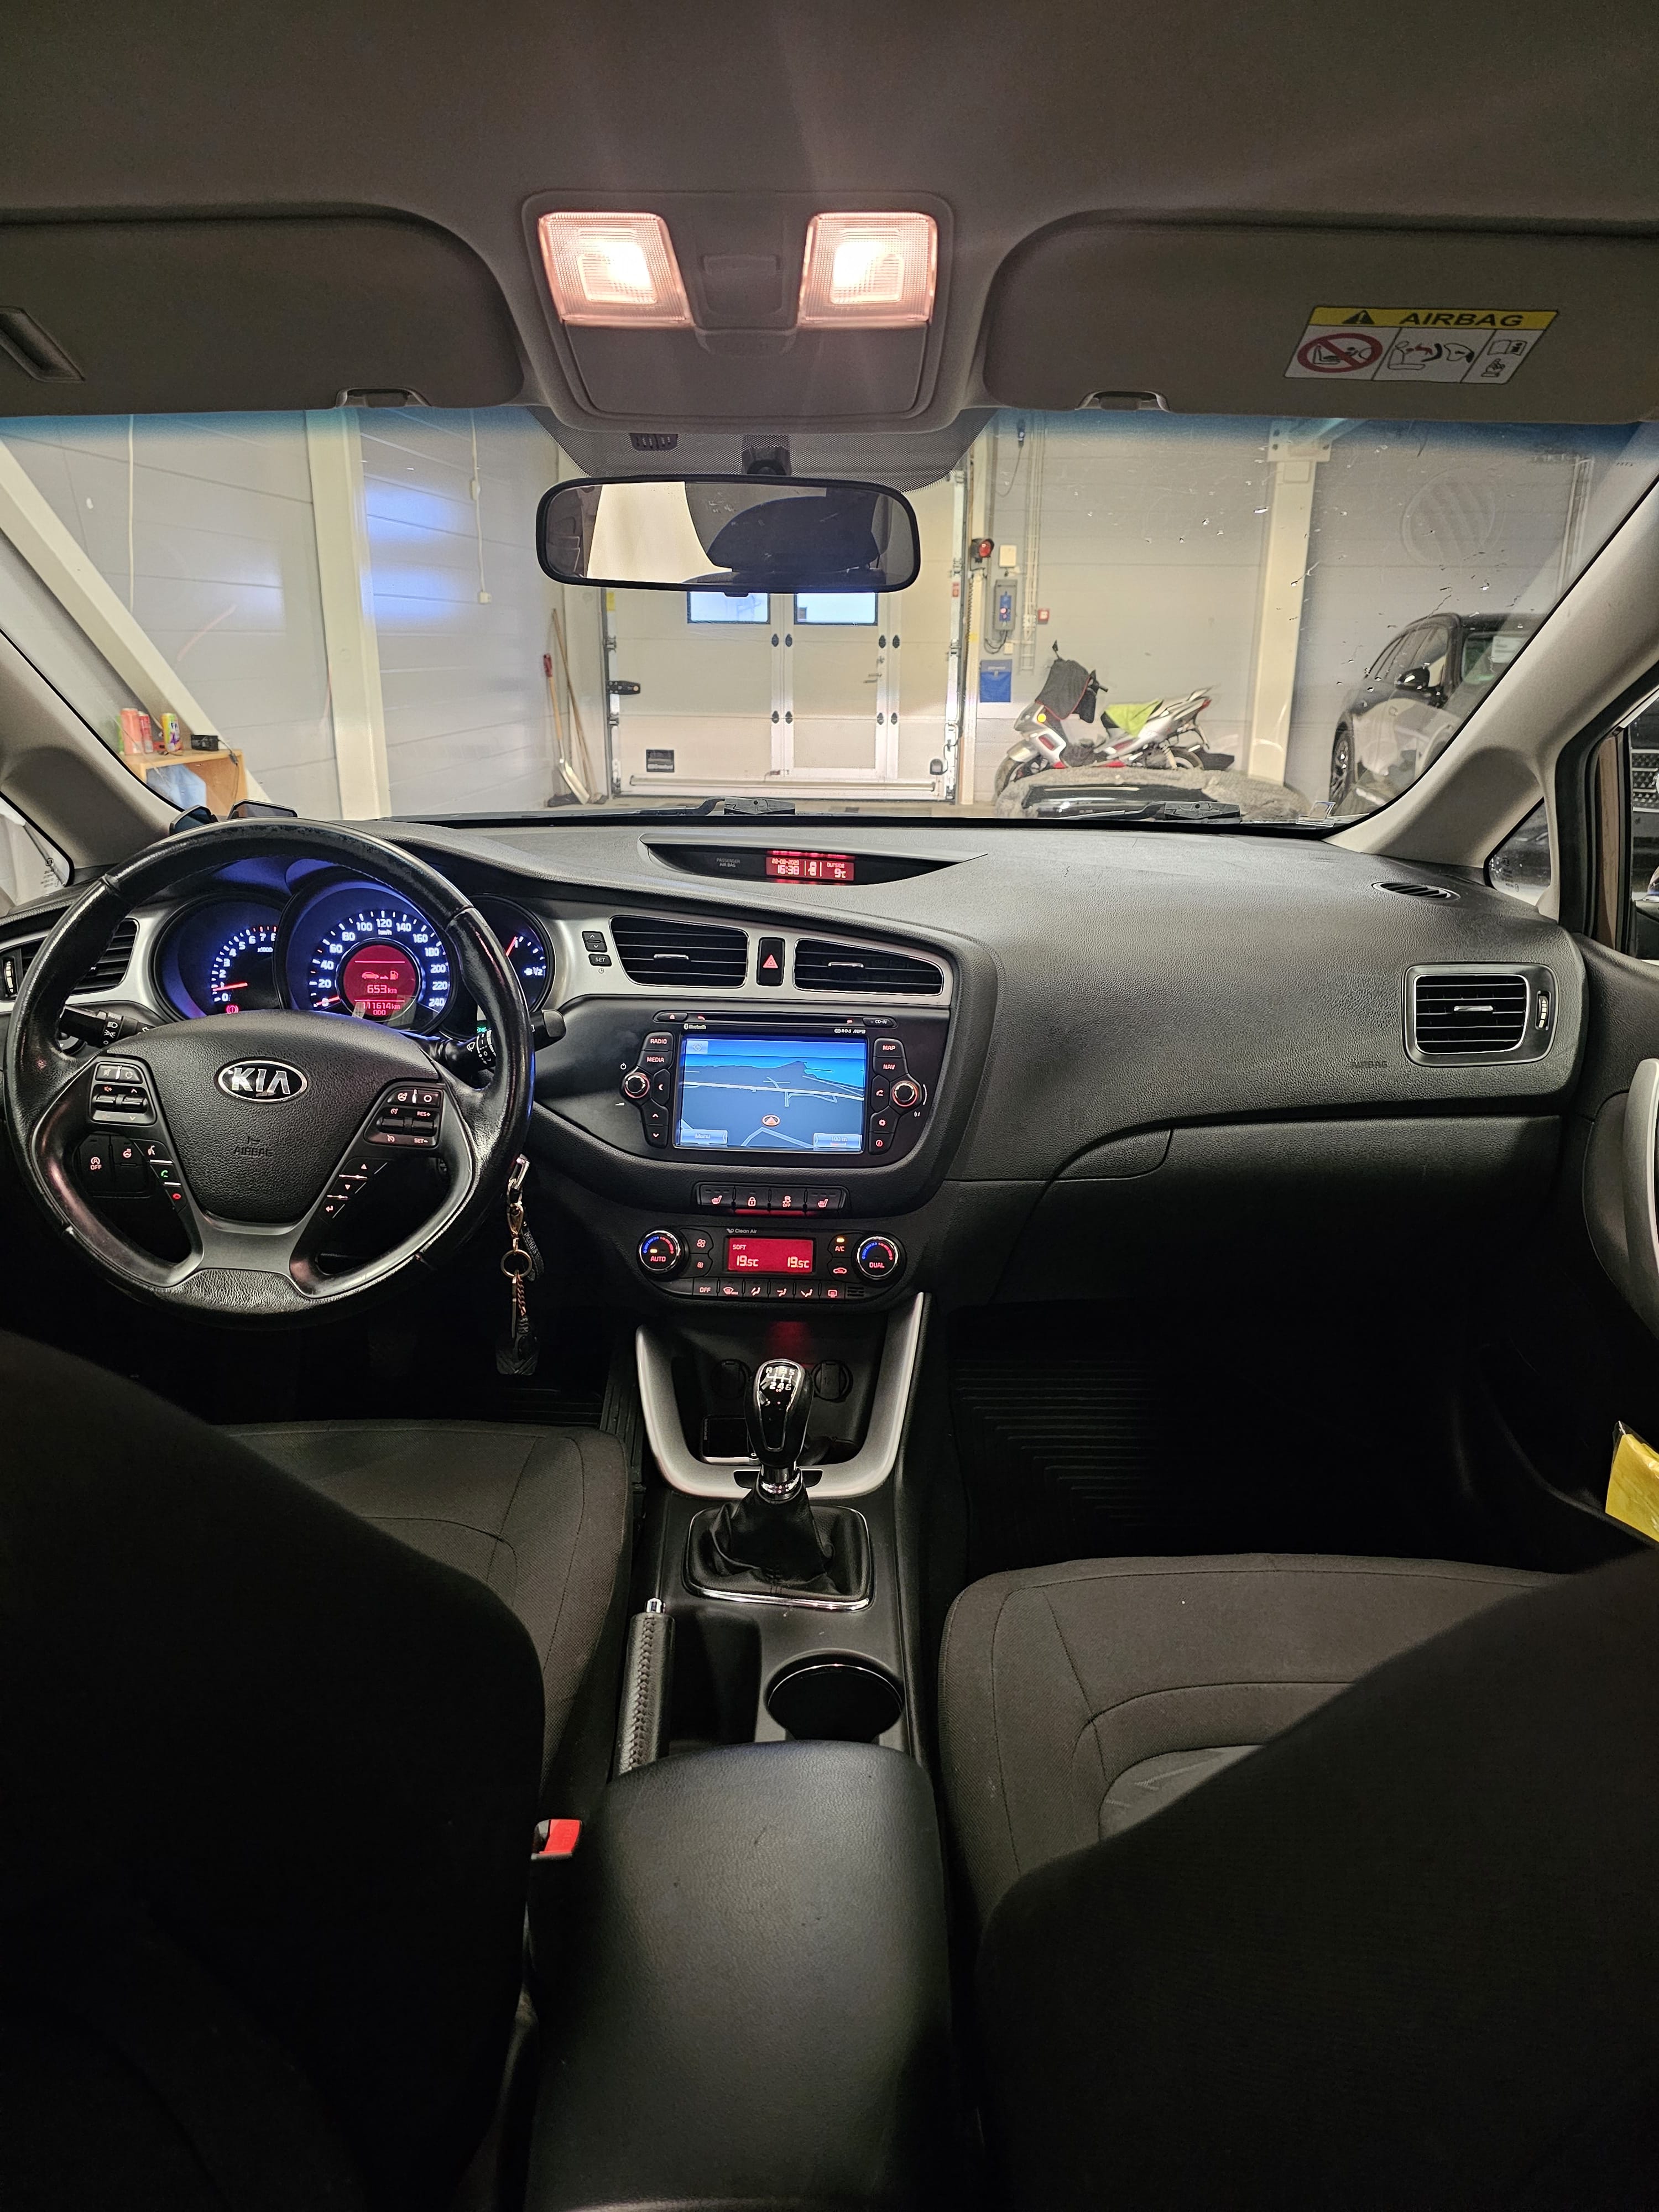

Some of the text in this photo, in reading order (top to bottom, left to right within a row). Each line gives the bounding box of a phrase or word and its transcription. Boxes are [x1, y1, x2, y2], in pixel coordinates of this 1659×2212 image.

[1400, 312, 1524, 327] AIRBAG
[778, 864, 799, 875] 16:38
[356, 922, 373, 932] 100
[376, 919, 392, 928] 120
[396, 922, 412, 932] 140
[249, 936, 256, 944] 6
[259, 933, 266, 941] 7
[342, 931, 356, 941] 80
[413, 934, 429, 943] 160
[238, 941, 246, 950] 5
[329, 943, 343, 953] 60
[229, 948, 237, 957] 4
[424, 947, 440, 957] 180
[223, 958, 231, 967] 3
[320, 960, 334, 970] 40
[430, 964, 446, 973] 200
[219, 969, 226, 978] 2
[318, 979, 332, 988] 20
[432, 981, 448, 991] 220
[222, 993, 229, 1002] 0
[429, 998, 445, 1008] 240
[231, 1067, 291, 1094] KIA
[769, 1381, 777, 1390] 2
